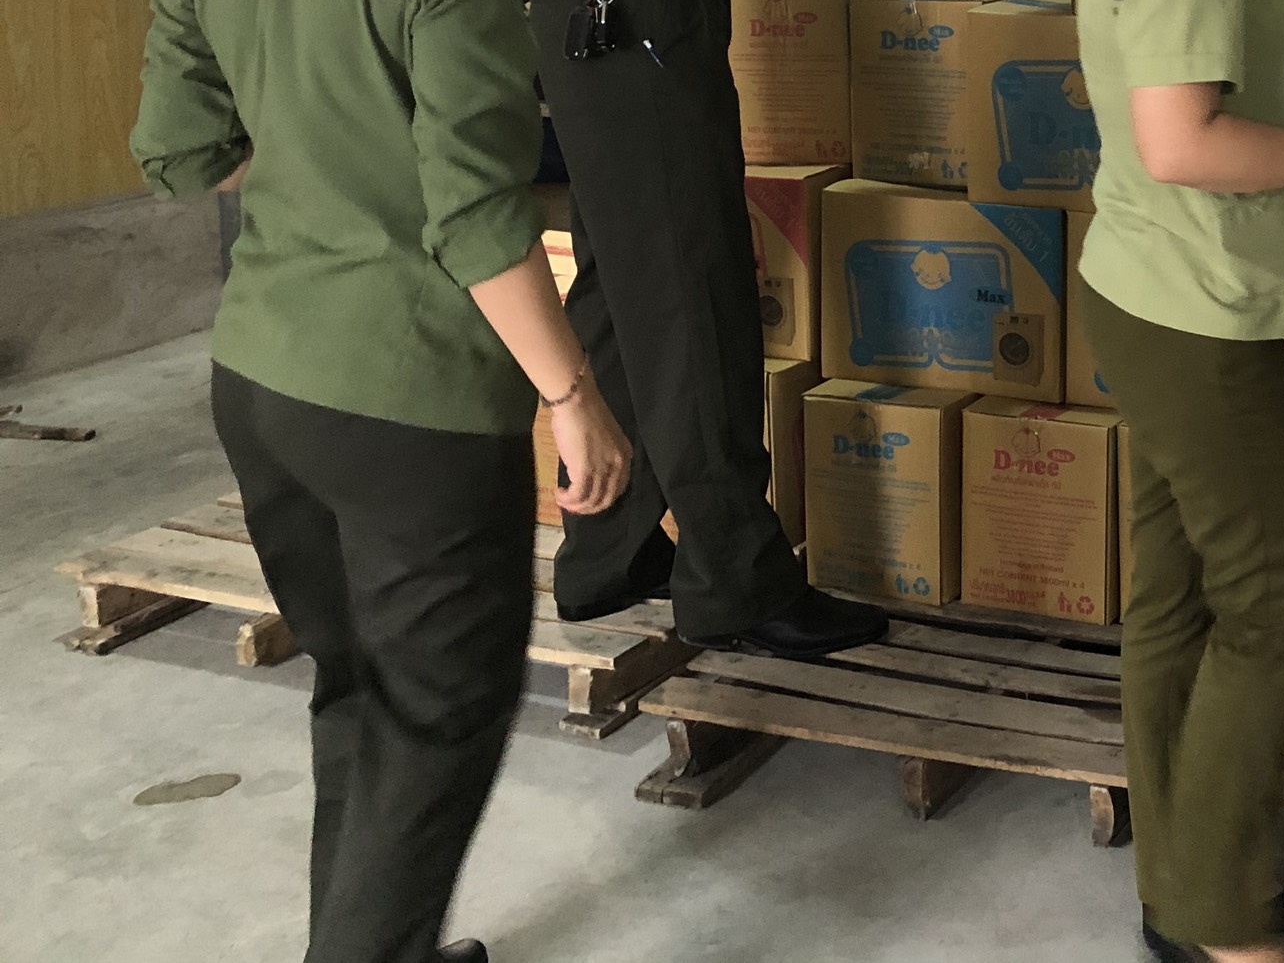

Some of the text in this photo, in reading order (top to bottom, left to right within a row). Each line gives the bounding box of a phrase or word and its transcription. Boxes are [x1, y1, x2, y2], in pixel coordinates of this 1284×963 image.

[880, 30, 941, 51] D-nee
[976, 289, 1006, 304] Max
[833, 435, 894, 460] D-nee
[993, 449, 1060, 476] D-nee
